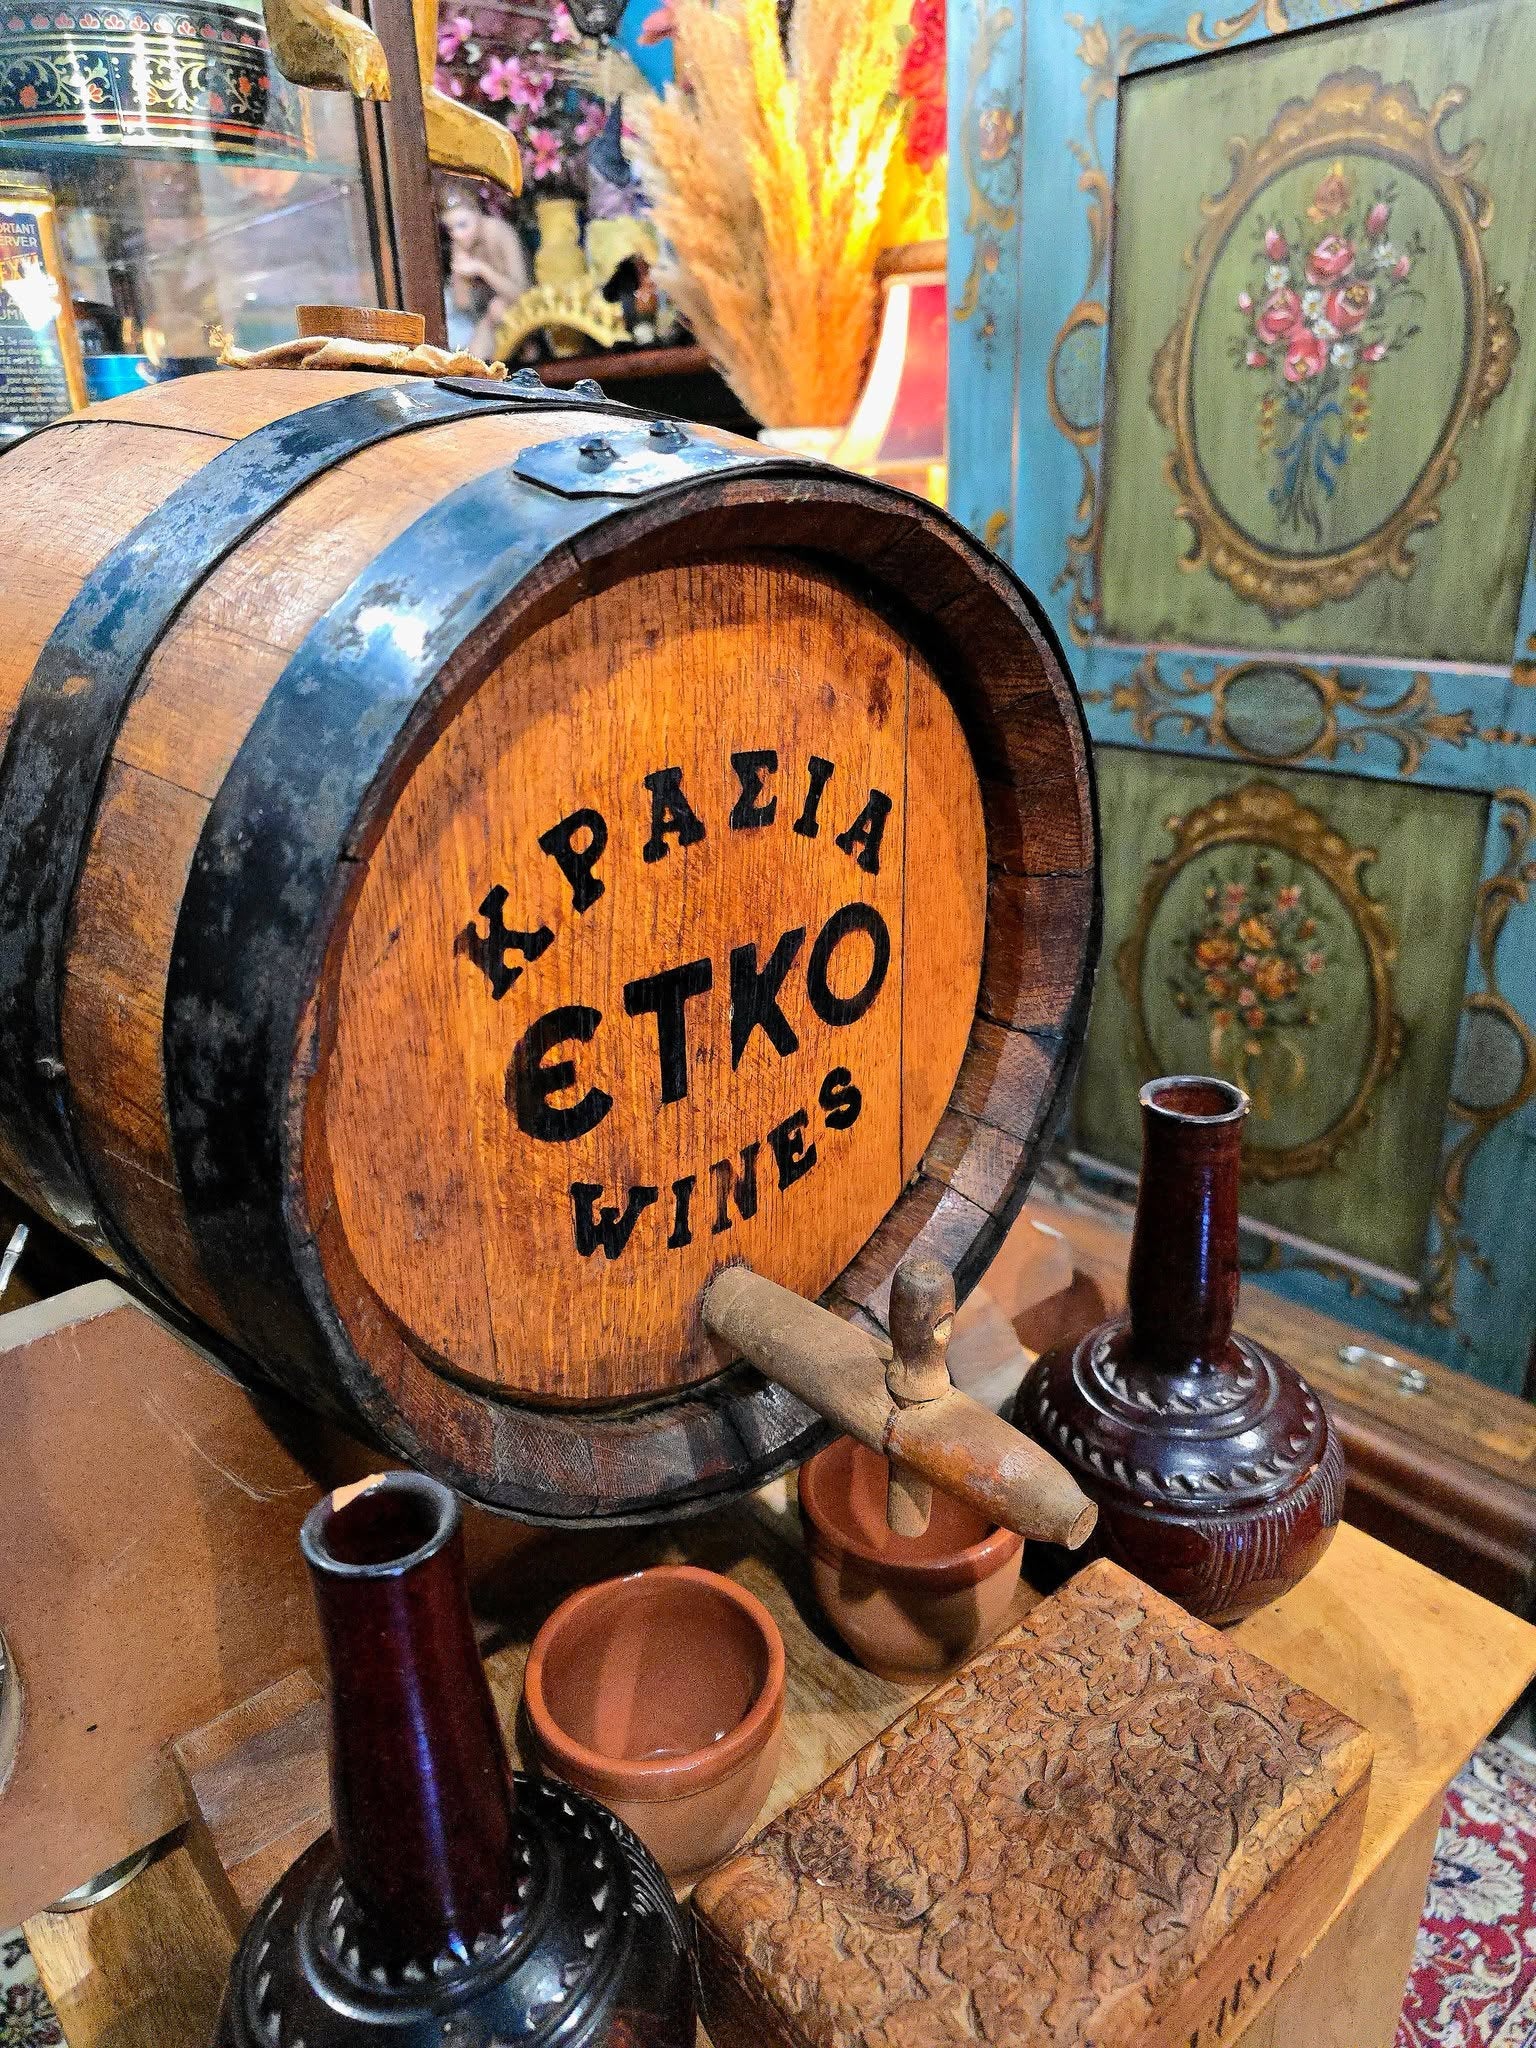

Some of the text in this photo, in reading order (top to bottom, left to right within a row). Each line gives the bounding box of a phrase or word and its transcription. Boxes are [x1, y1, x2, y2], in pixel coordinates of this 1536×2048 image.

[453, 749, 893, 1001] ΚΡΑΣΙΑ
[503, 901, 891, 1145] ETKO
[568, 1066, 863, 1261] WINES
